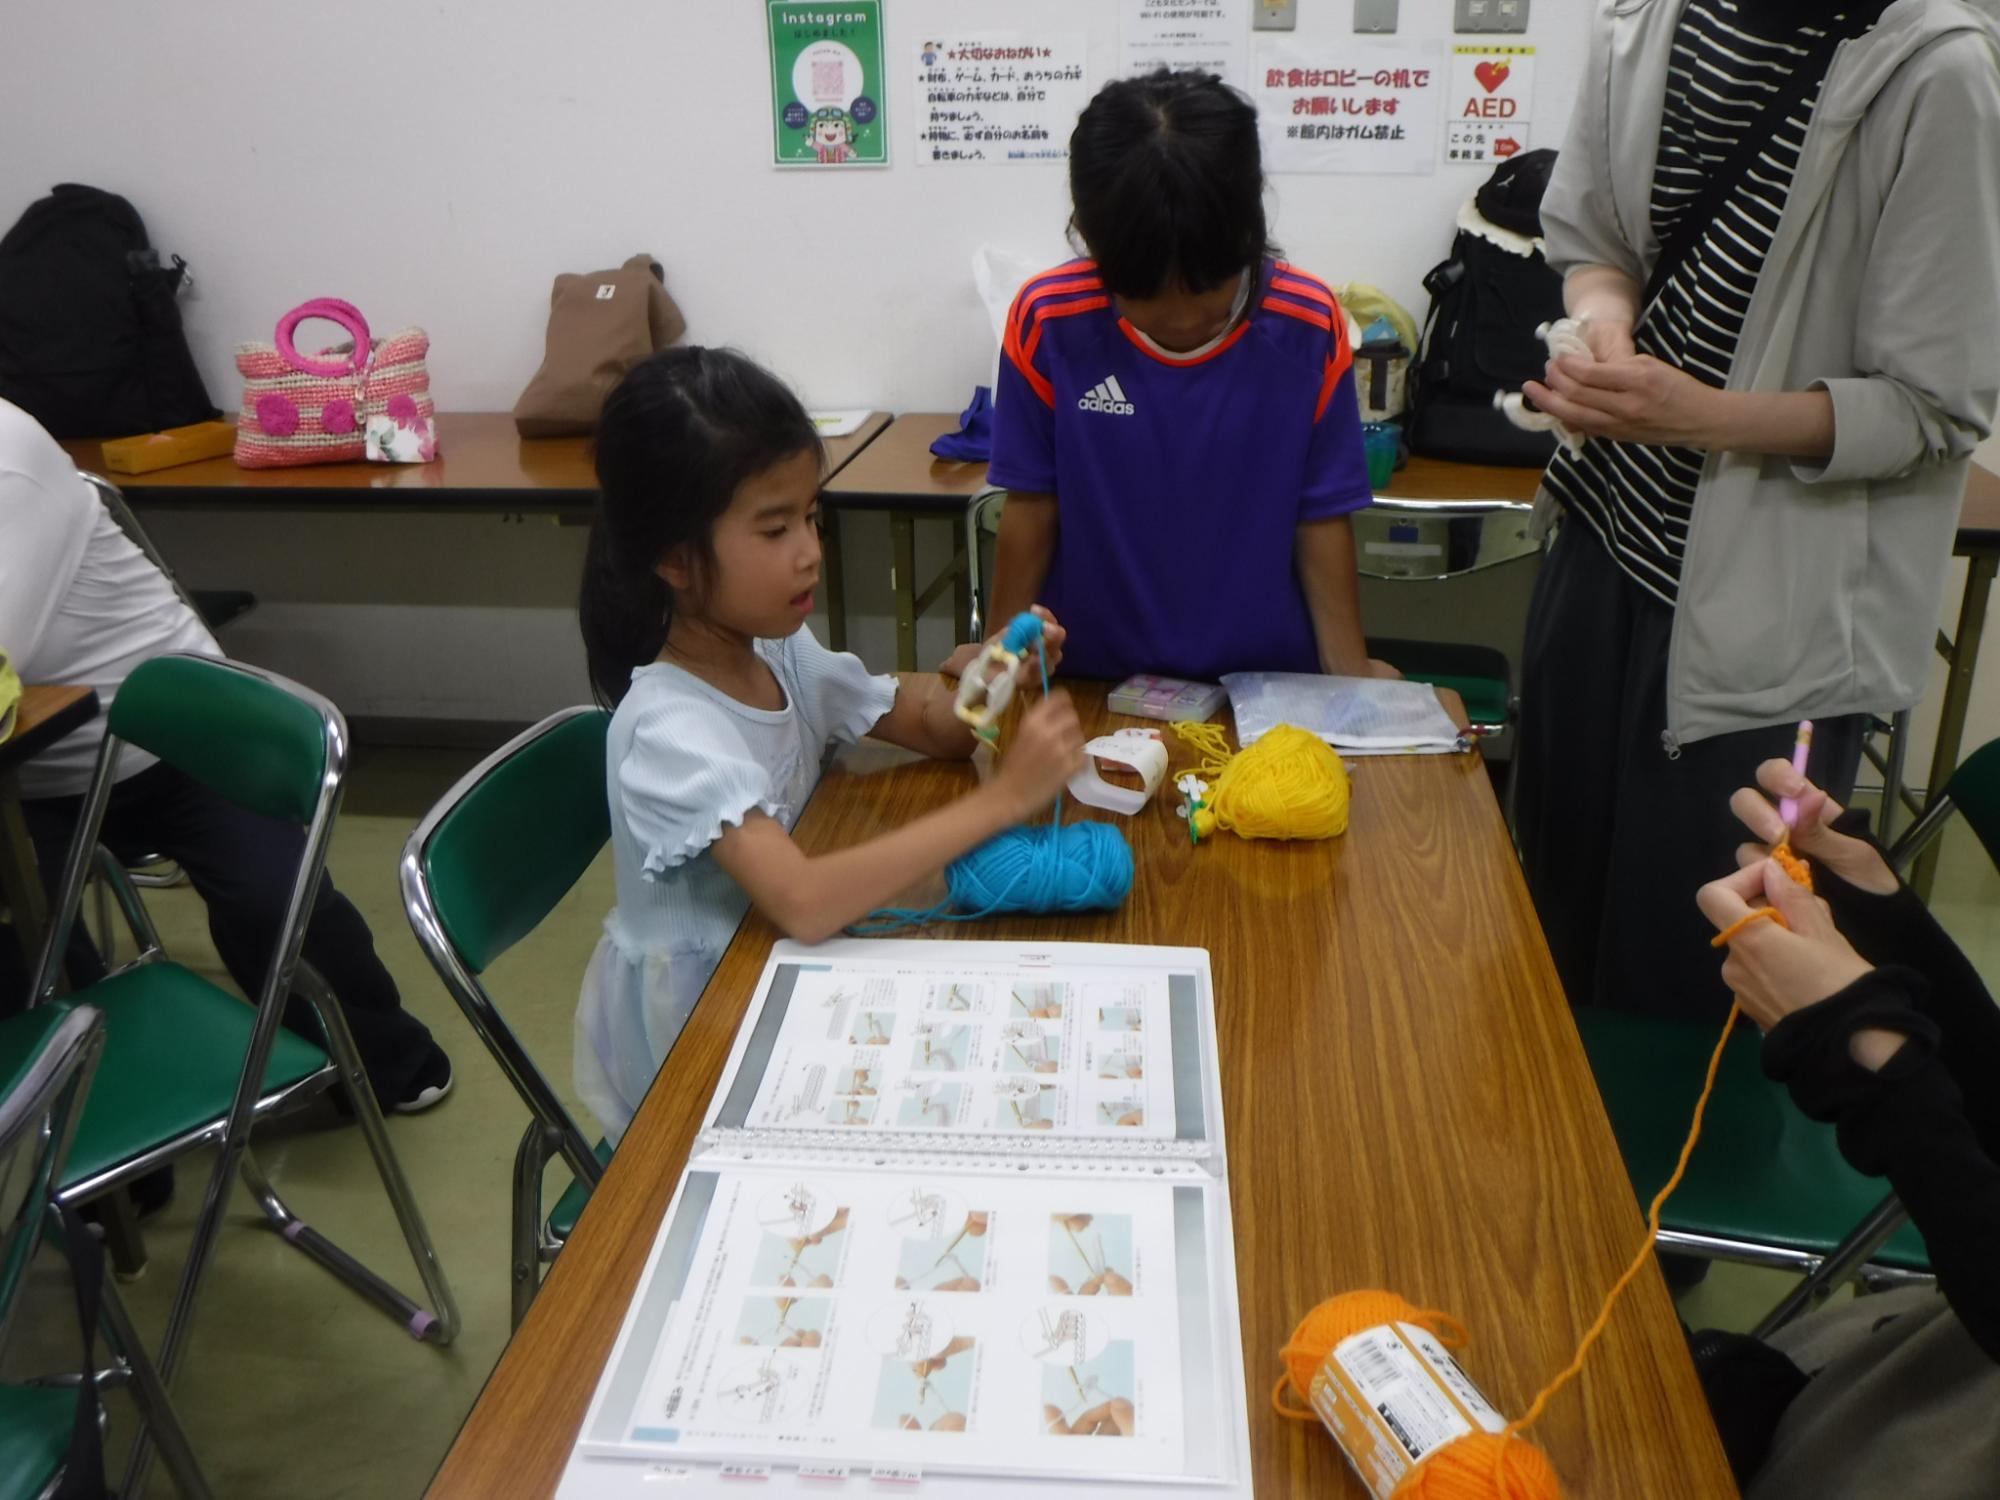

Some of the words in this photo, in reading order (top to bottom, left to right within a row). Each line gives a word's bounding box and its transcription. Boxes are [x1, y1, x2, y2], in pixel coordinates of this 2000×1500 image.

[783, 11, 866, 26] Instagram
[1266, 68, 1430, 88] 飲食はロビーの机で
[1292, 96, 1400, 115] お願いします
[1463, 97, 1516, 118] AED
[1451, 134, 1486, 145] この先
[1078, 398, 1135, 415] adidas
